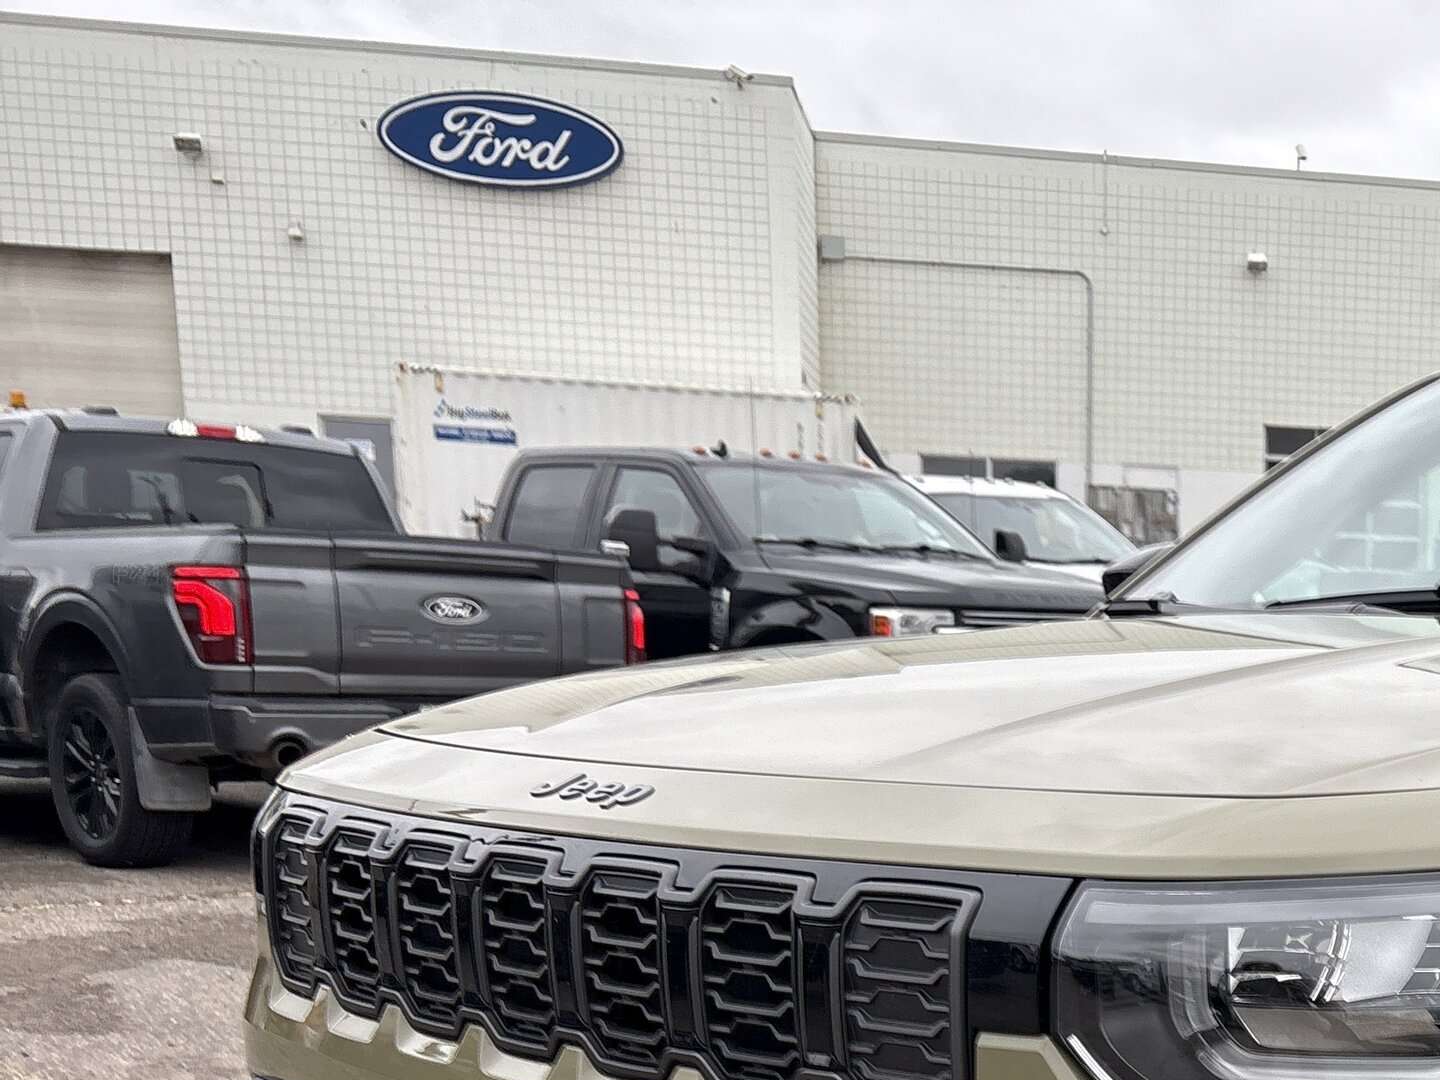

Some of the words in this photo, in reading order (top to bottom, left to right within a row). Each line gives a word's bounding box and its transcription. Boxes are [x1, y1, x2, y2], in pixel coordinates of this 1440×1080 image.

[429, 105, 572, 171] Ford
[433, 600, 473, 617] Ford
[529, 773, 656, 810] Jeep
